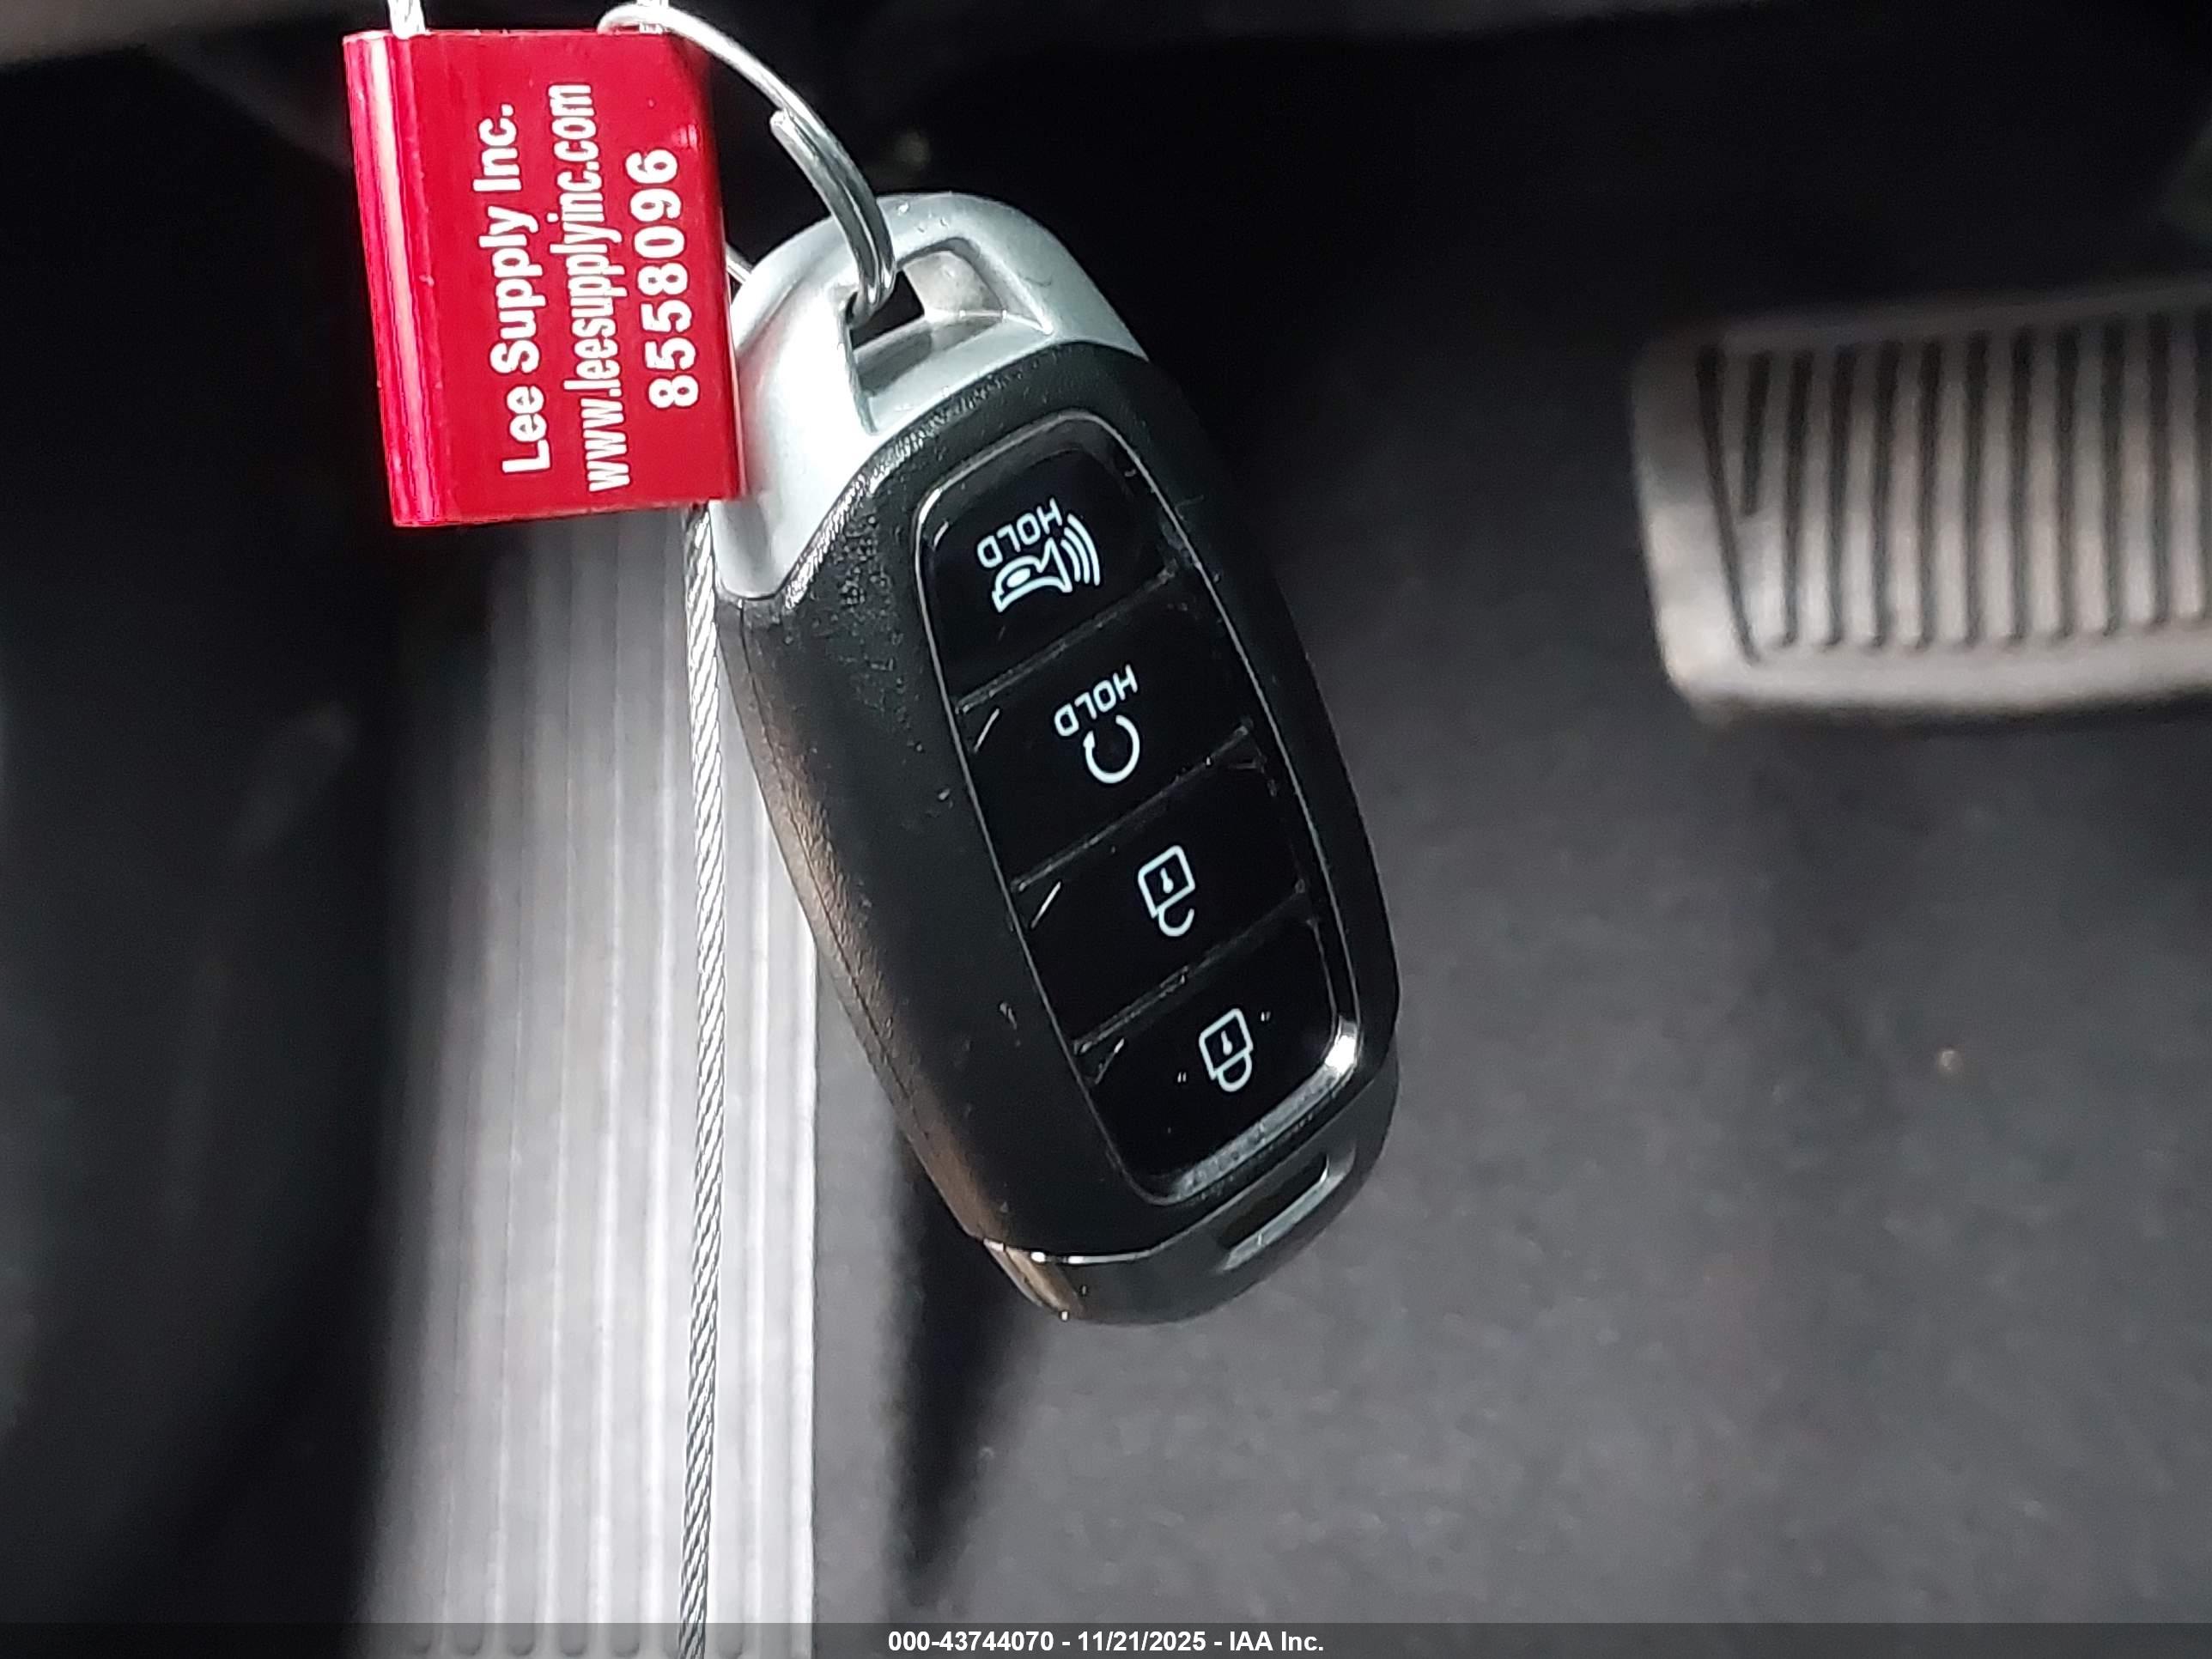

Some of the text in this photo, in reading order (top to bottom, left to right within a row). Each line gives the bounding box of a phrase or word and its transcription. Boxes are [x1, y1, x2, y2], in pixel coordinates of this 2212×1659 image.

[472, 103, 550, 473] Lee Supply Inc.
[546, 83, 630, 492] www.leesupplyinc.com
[625, 149, 699, 409] 8558096
[977, 497, 1063, 568] HOLD
[1054, 664, 1139, 737] HOLD
